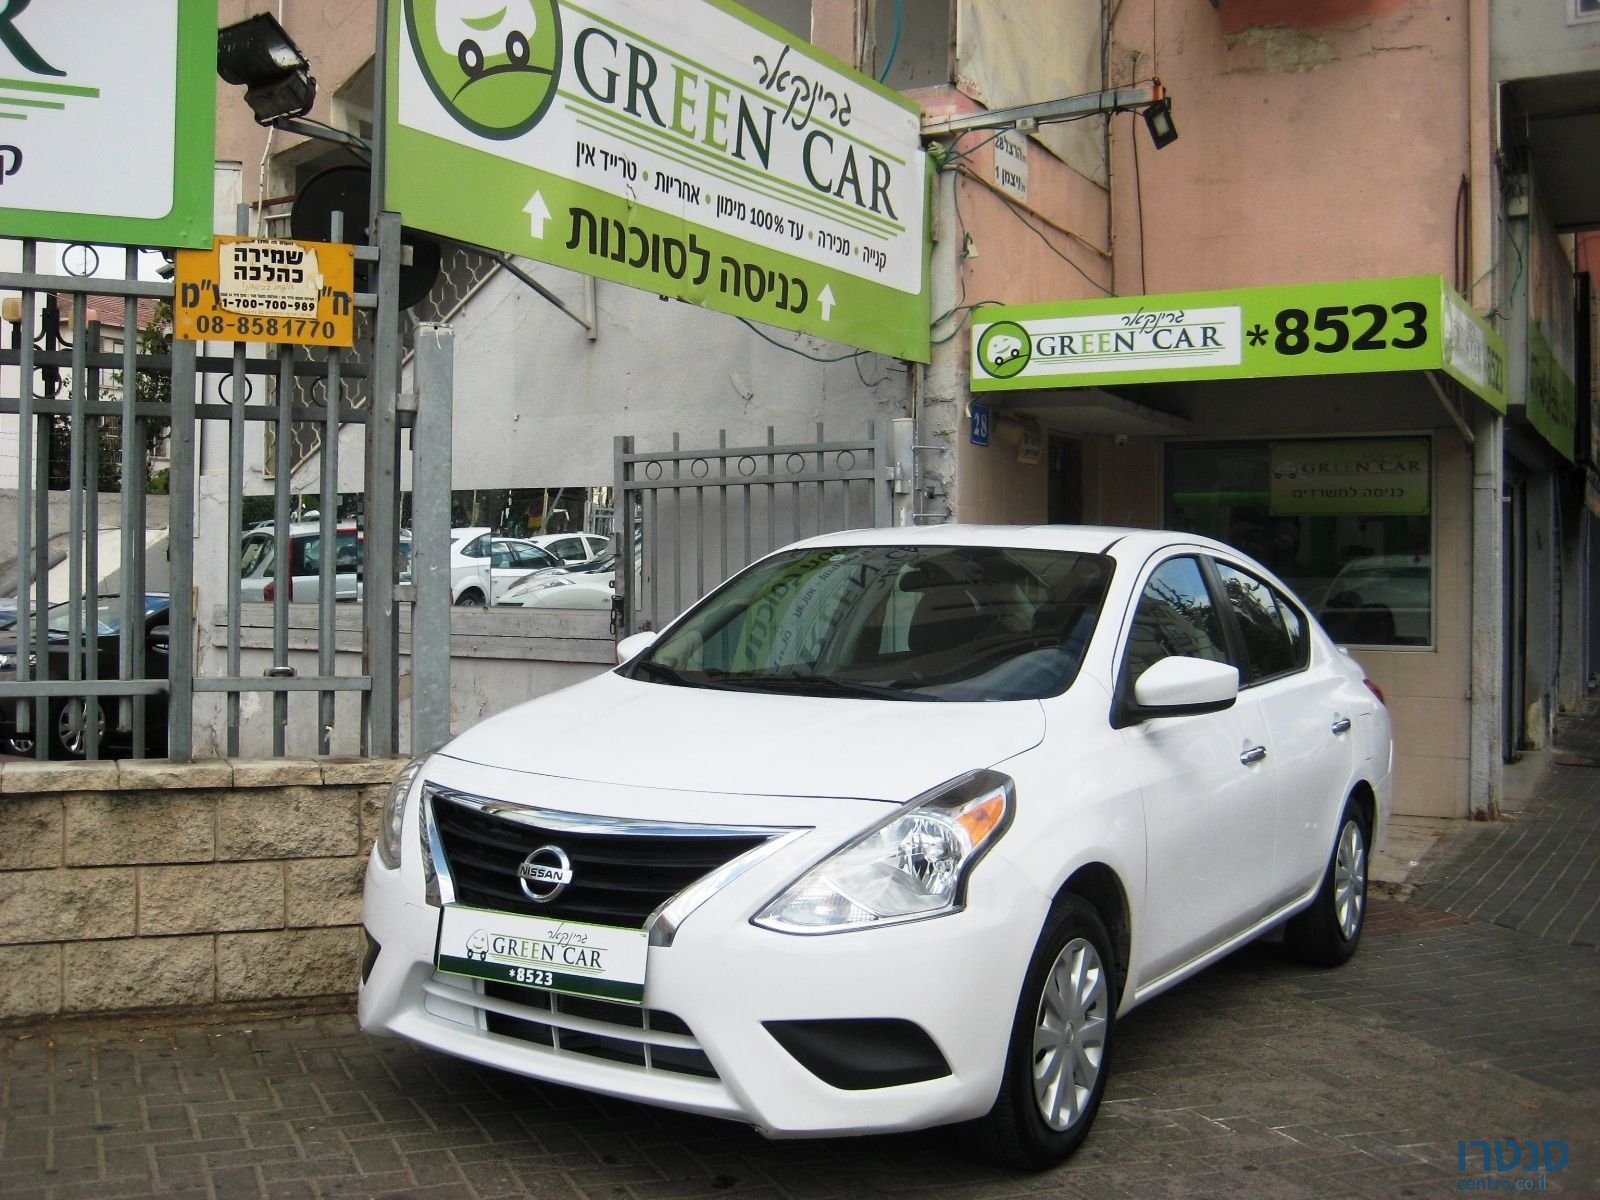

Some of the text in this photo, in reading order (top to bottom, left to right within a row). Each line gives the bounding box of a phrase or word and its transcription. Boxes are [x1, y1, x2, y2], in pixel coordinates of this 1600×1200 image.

[574, 27, 899, 221] GREEN CAR
[576, 141, 887, 272] קנייה מכירה עד 100% מימון אחריות טרייד אין
[234, 247, 304, 266] שמירה
[565, 207, 809, 314] כניסה לסוכנות
[234, 265, 304, 284] כהלכה
[222, 298, 315, 312] 1-700-700-989
[196, 315, 335, 339] 08-8581770
[1036, 326, 1223, 357] GREEN CAR
[973, 412, 988, 438] 28
[1301, 460, 1421, 474] GREEN CAR
[1292, 486, 1404, 499] כניסה למשרדים
[519, 865, 564, 882] NISSAN
[492, 937, 602, 969] GREEN CAR
